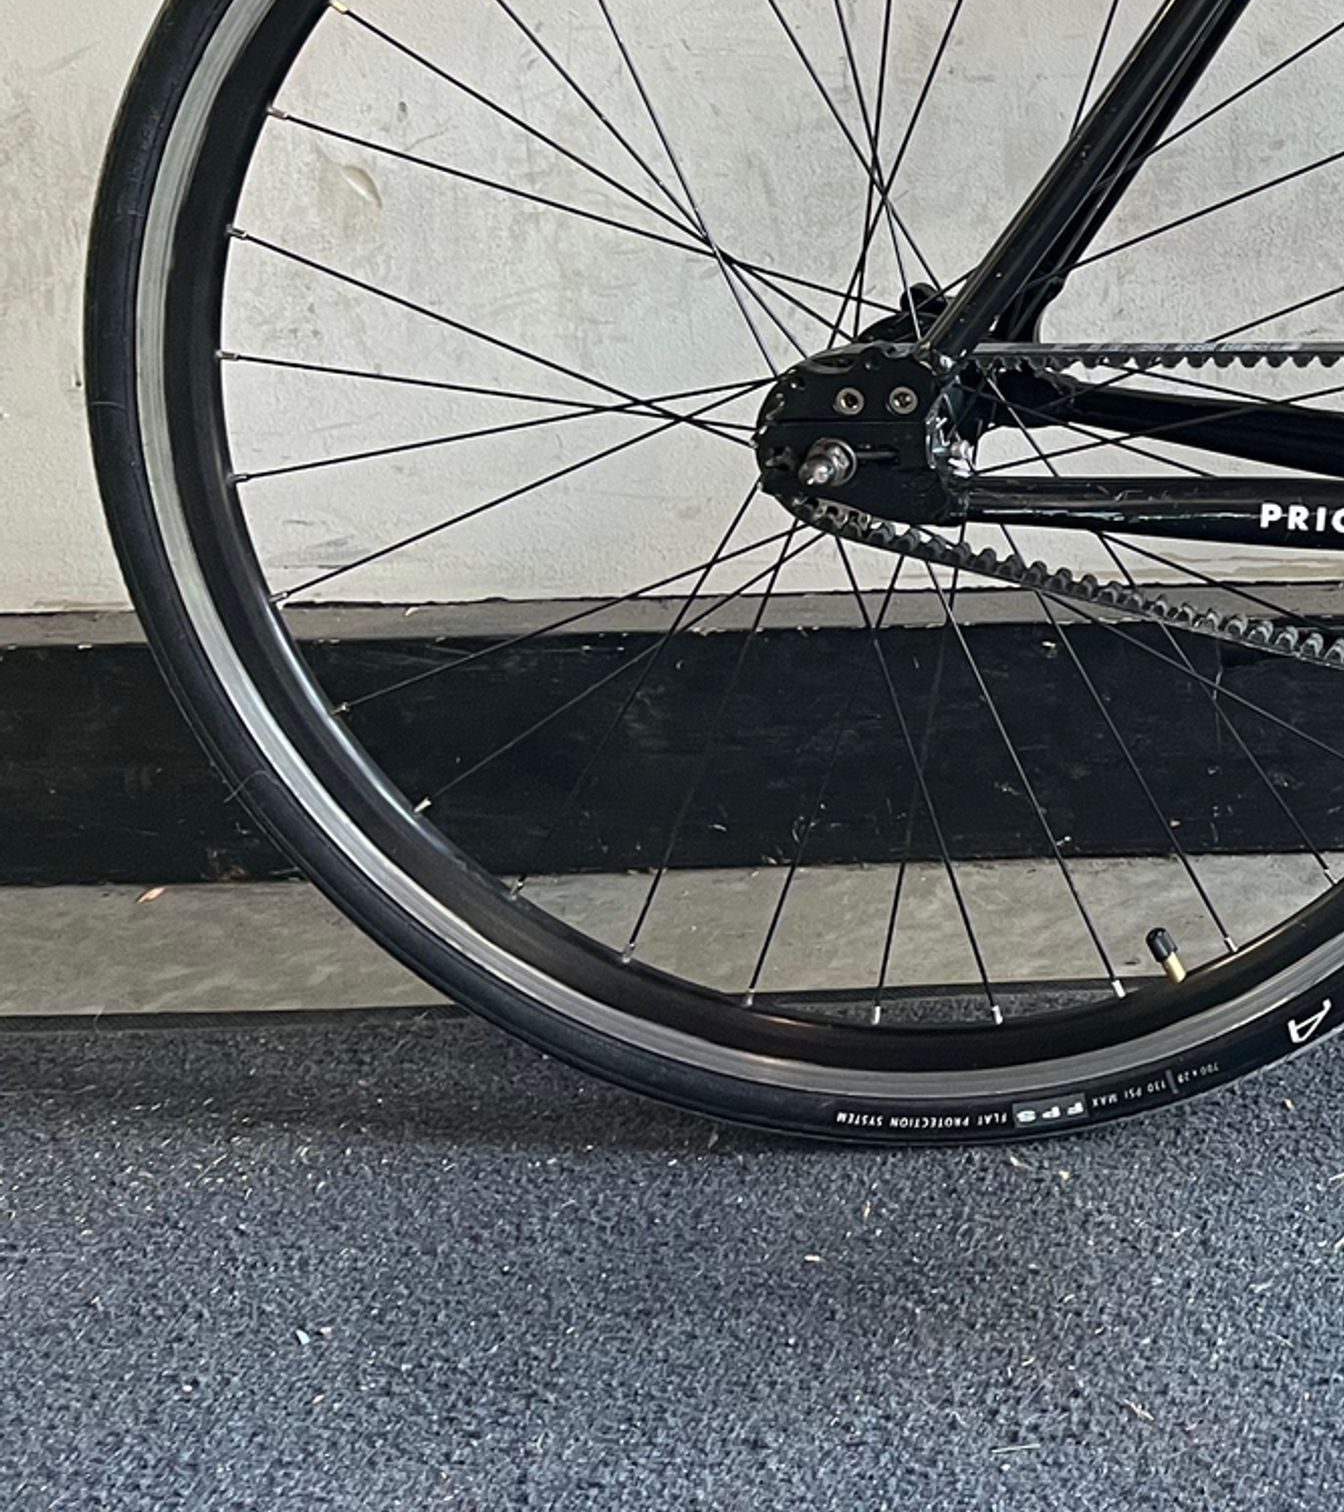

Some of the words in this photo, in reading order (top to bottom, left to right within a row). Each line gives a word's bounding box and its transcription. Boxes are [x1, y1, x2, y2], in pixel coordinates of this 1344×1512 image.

[1091, 1092, 1119, 1108] MAX
[1122, 1085, 1142, 1100] PSI
[836, 1111, 884, 1128] SYSTEM
[977, 1111, 1008, 1127] FLAT
[1015, 1100, 1085, 1123] FPS
[889, 1114, 970, 1130] PROTECTION
